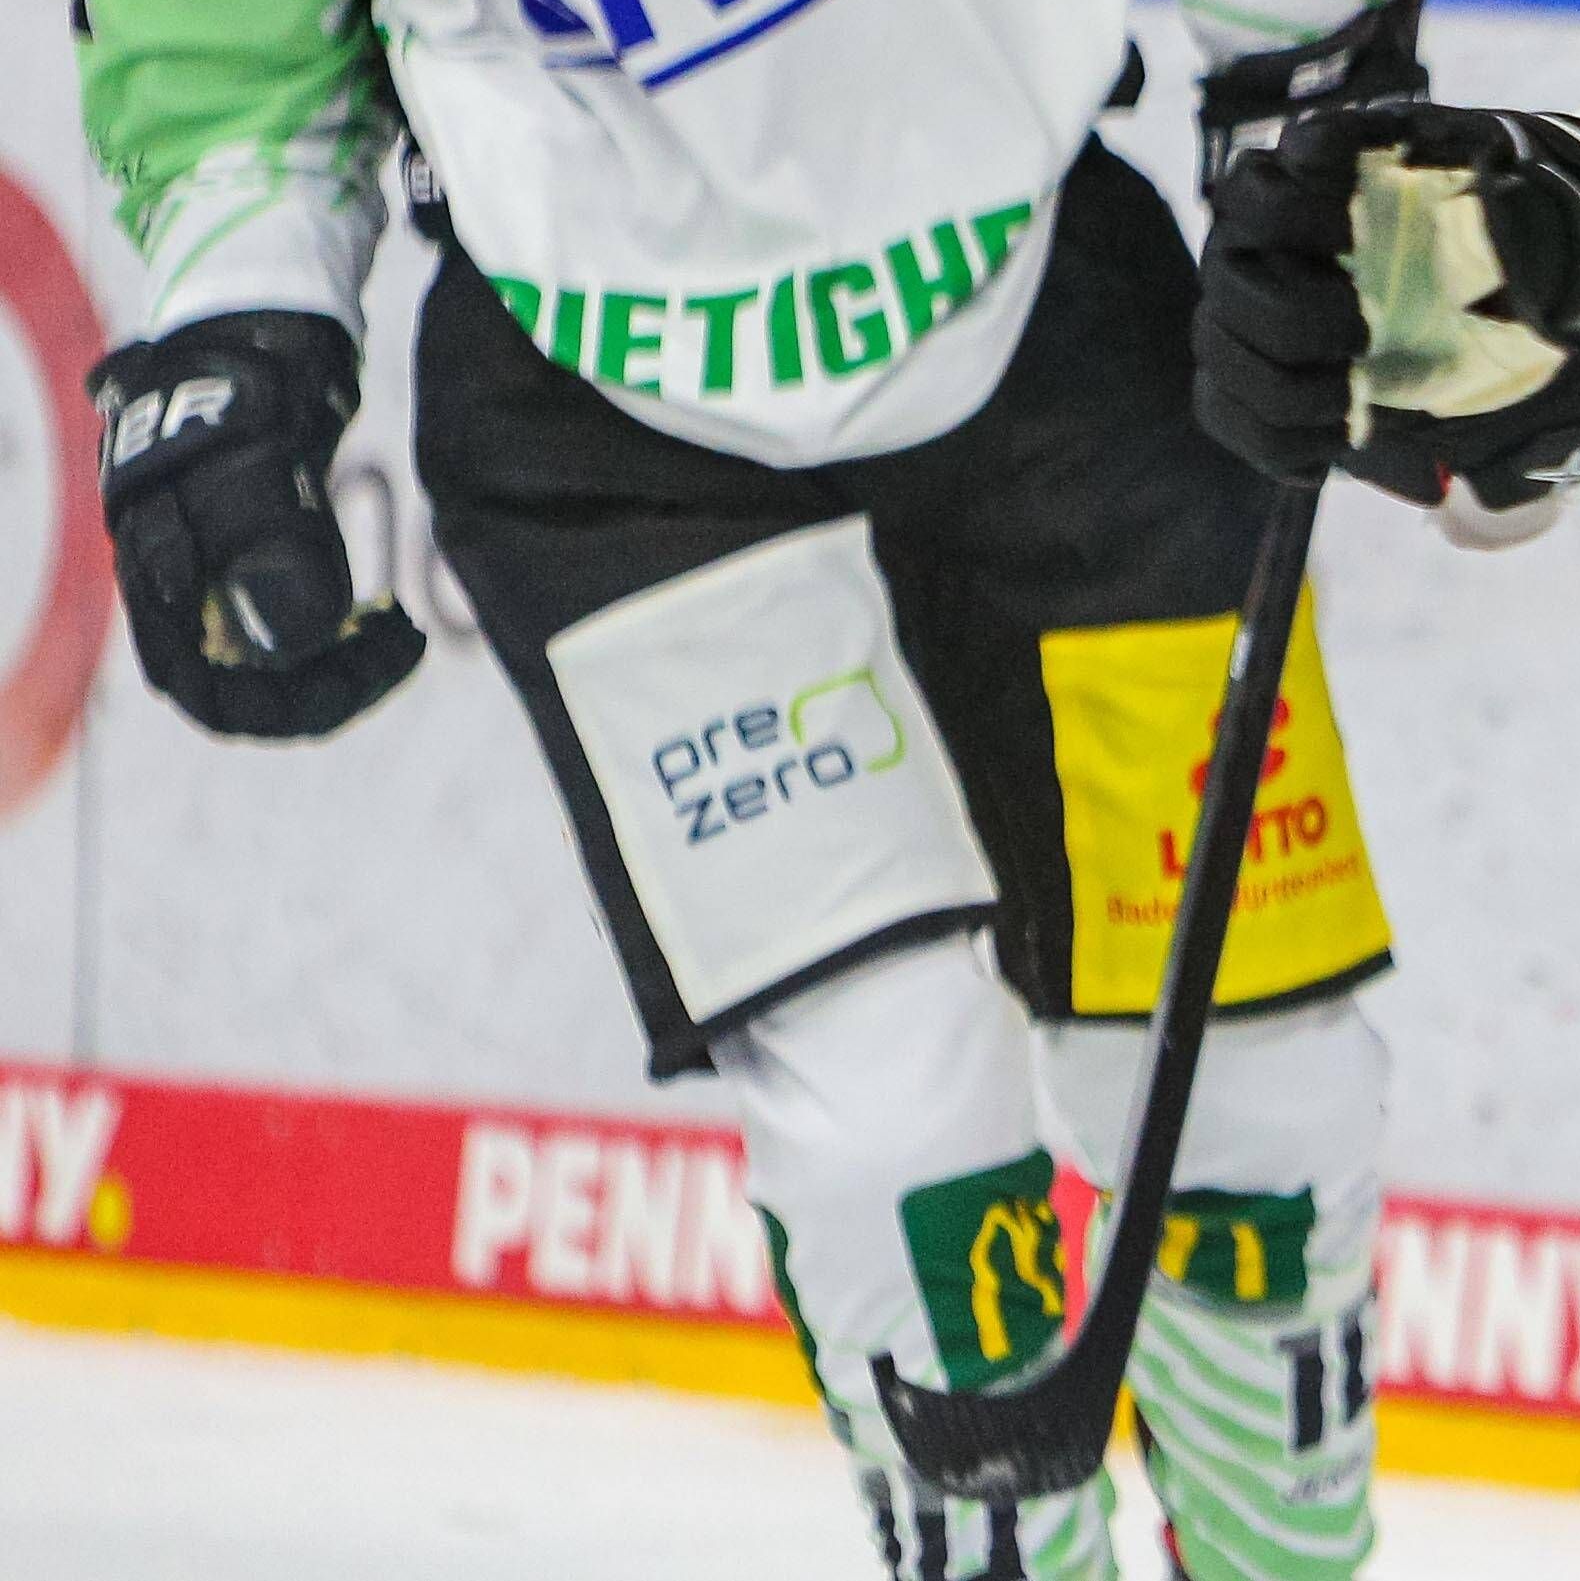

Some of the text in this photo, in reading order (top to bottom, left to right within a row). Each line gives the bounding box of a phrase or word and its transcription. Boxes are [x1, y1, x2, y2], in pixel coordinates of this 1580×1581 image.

[652, 701, 782, 802] pre
[673, 742, 858, 849] zero
[1160, 796, 1326, 880] LTTO
[451, 1118, 768, 1316] PENN
